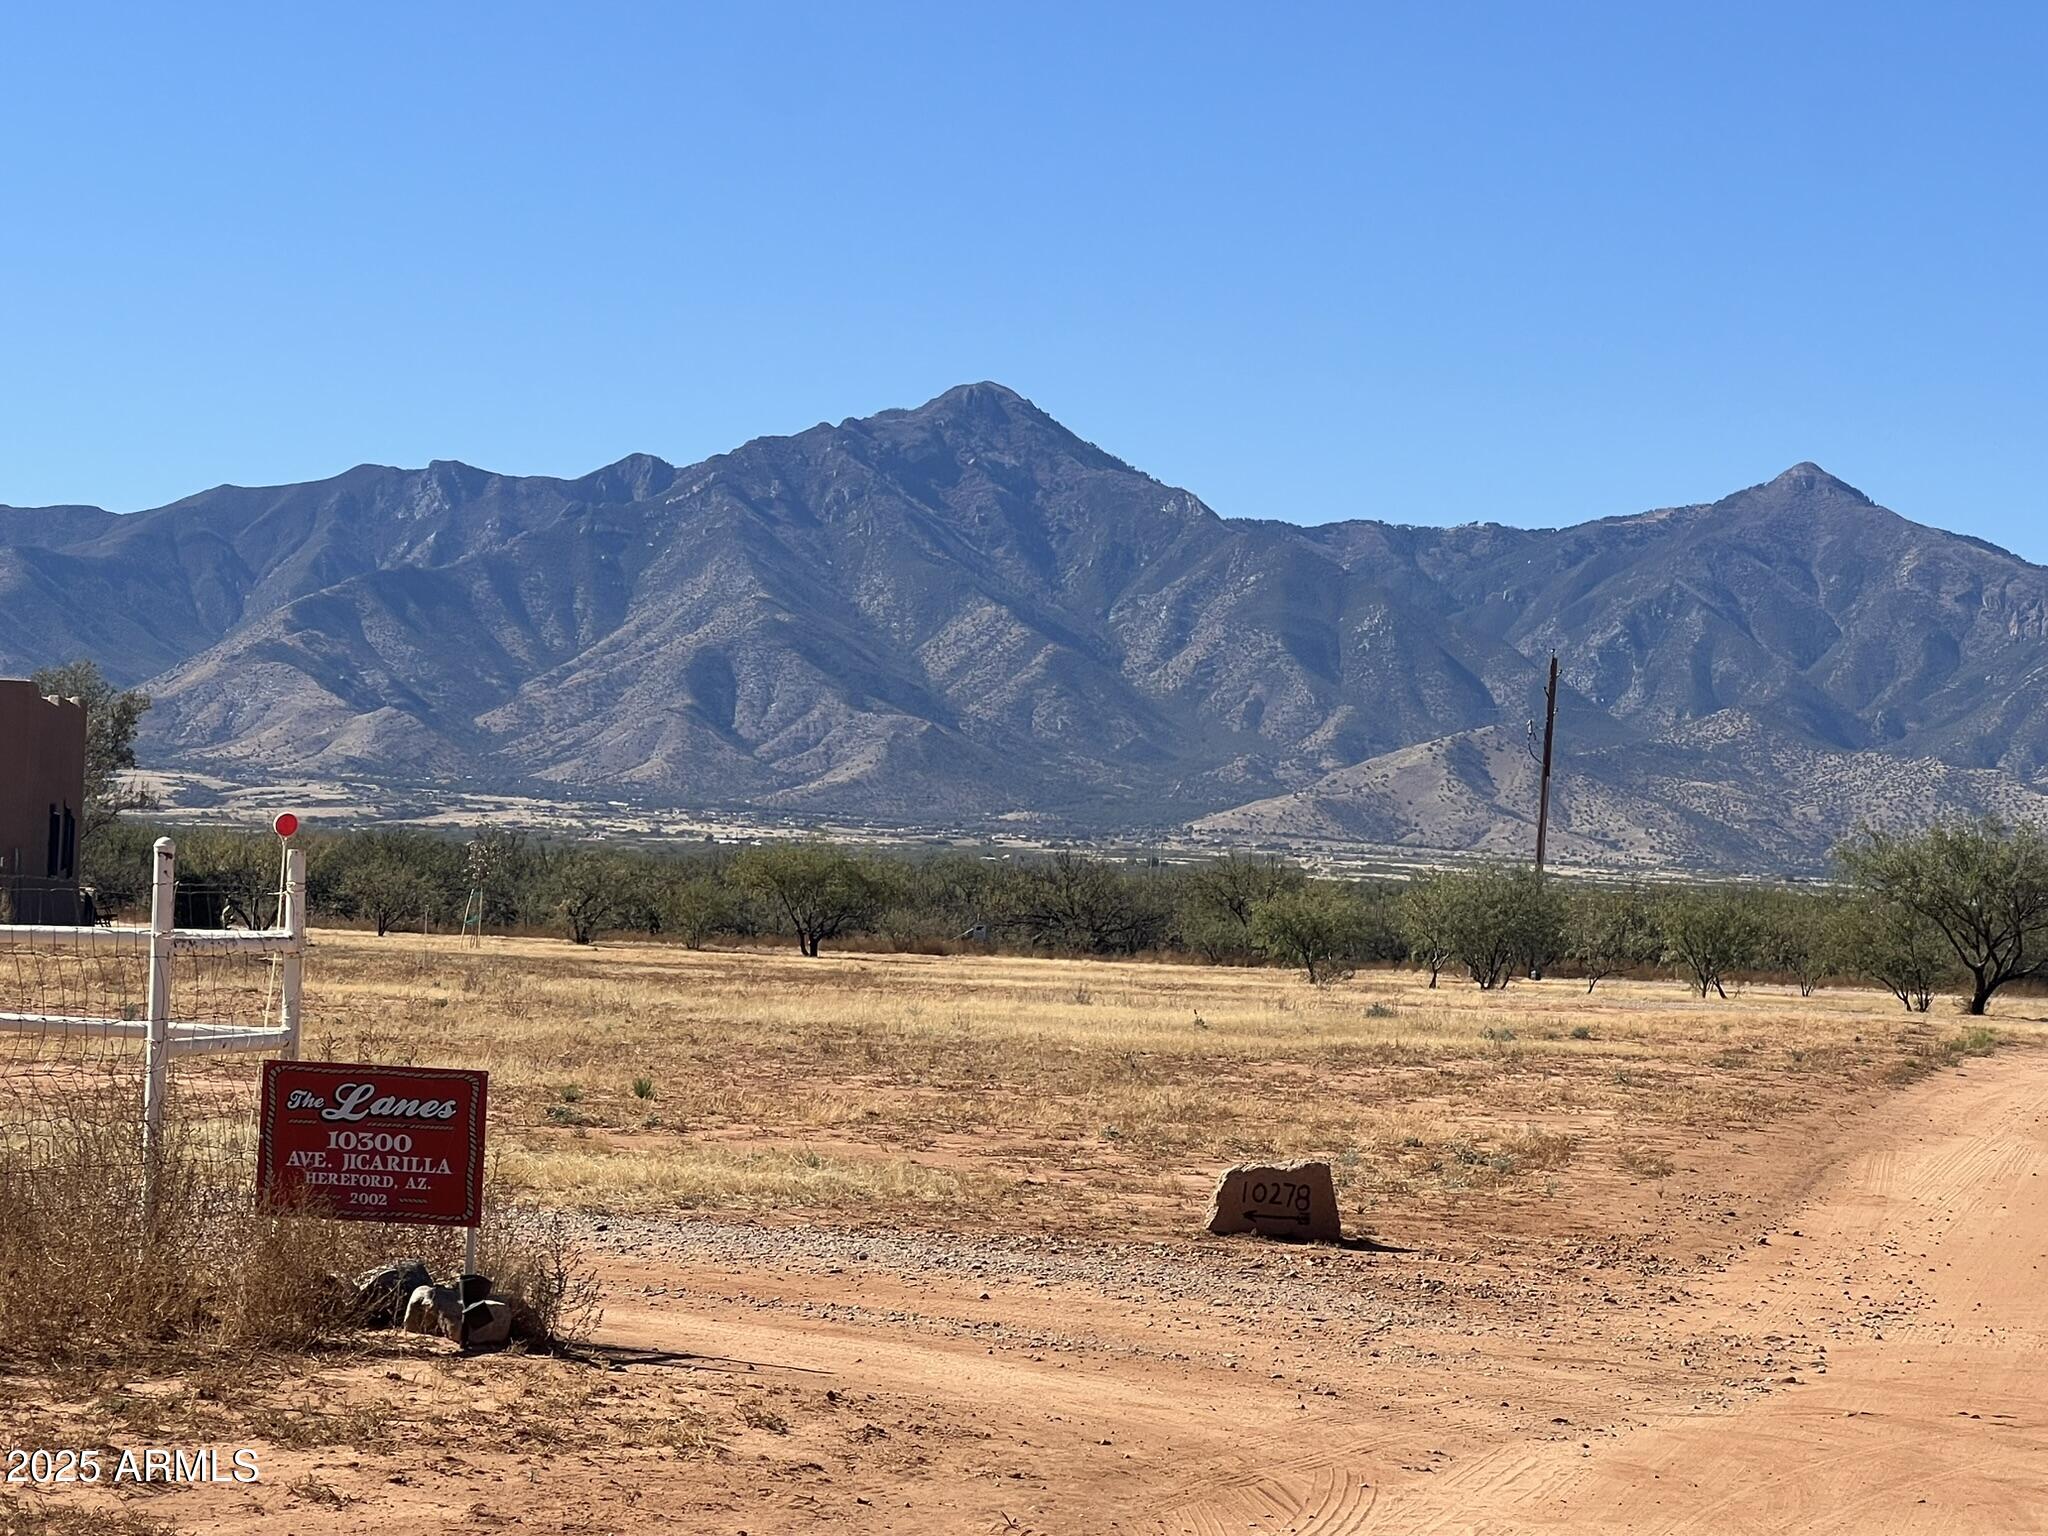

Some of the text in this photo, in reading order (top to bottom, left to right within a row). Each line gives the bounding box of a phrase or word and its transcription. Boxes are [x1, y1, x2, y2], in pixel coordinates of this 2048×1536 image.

[287, 1083, 457, 1121] The Lanes
[326, 1131, 412, 1153] 10300
[286, 1151, 452, 1175] AVE. JICARILLA
[405, 1177, 432, 1190] AZ.
[350, 1193, 388, 1206] 2002
[1242, 1181, 1311, 1211] 10278
